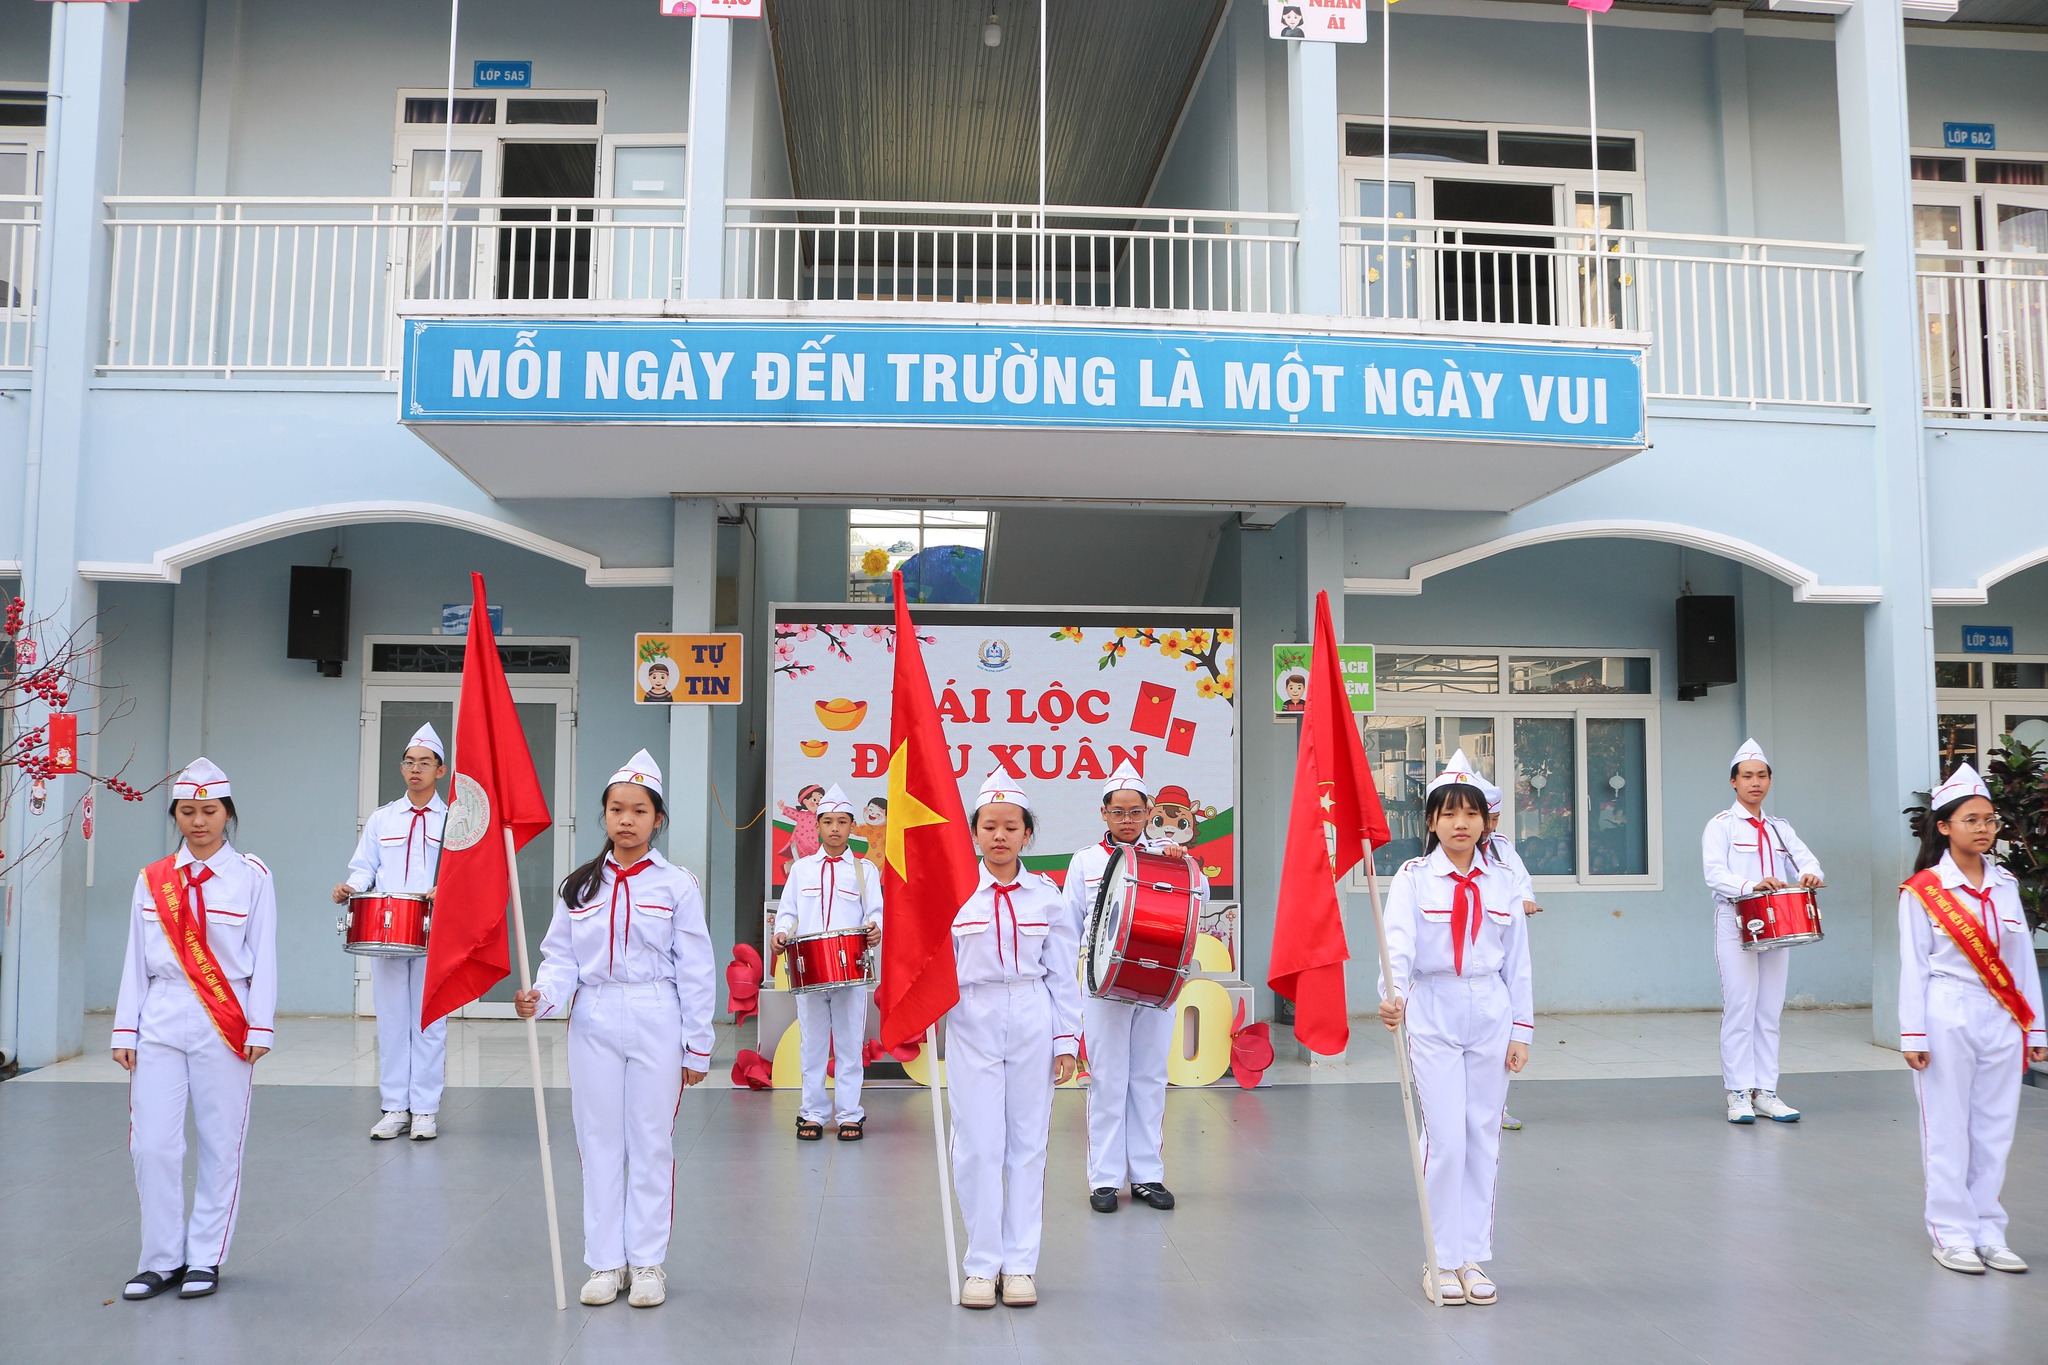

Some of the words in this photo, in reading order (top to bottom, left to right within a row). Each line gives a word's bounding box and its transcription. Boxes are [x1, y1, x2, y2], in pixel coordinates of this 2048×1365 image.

[1327, 14, 1345, 29] ÁI
[480, 67, 501, 80] LỚP
[504, 70, 525, 81] 5A5
[1948, 128, 1969, 143] LỚP
[1971, 131, 1991, 145] 6A2
[453, 330, 560, 398] MỖI
[586, 340, 734, 400] NGÀY
[752, 335, 864, 401] ĐẾN
[888, 343, 1115, 405] TRƯỜNG
[1140, 348, 1203, 408] LÀ
[1225, 348, 1344, 423] MỘT
[1365, 359, 1503, 418] NGÀY
[1520, 375, 1607, 424] VUI
[1967, 631, 1986, 646] LỚP
[1988, 635, 2008, 647] 3A4
[691, 642, 727, 668] TỰ
[685, 676, 730, 695] TIN
[1006, 681, 1110, 731] LỘC
[987, 737, 1147, 780] XUÂN
[188, 941, 208, 965] PHONG
[205, 973, 221, 987] CHÍ
[212, 984, 228, 1004] MINH
